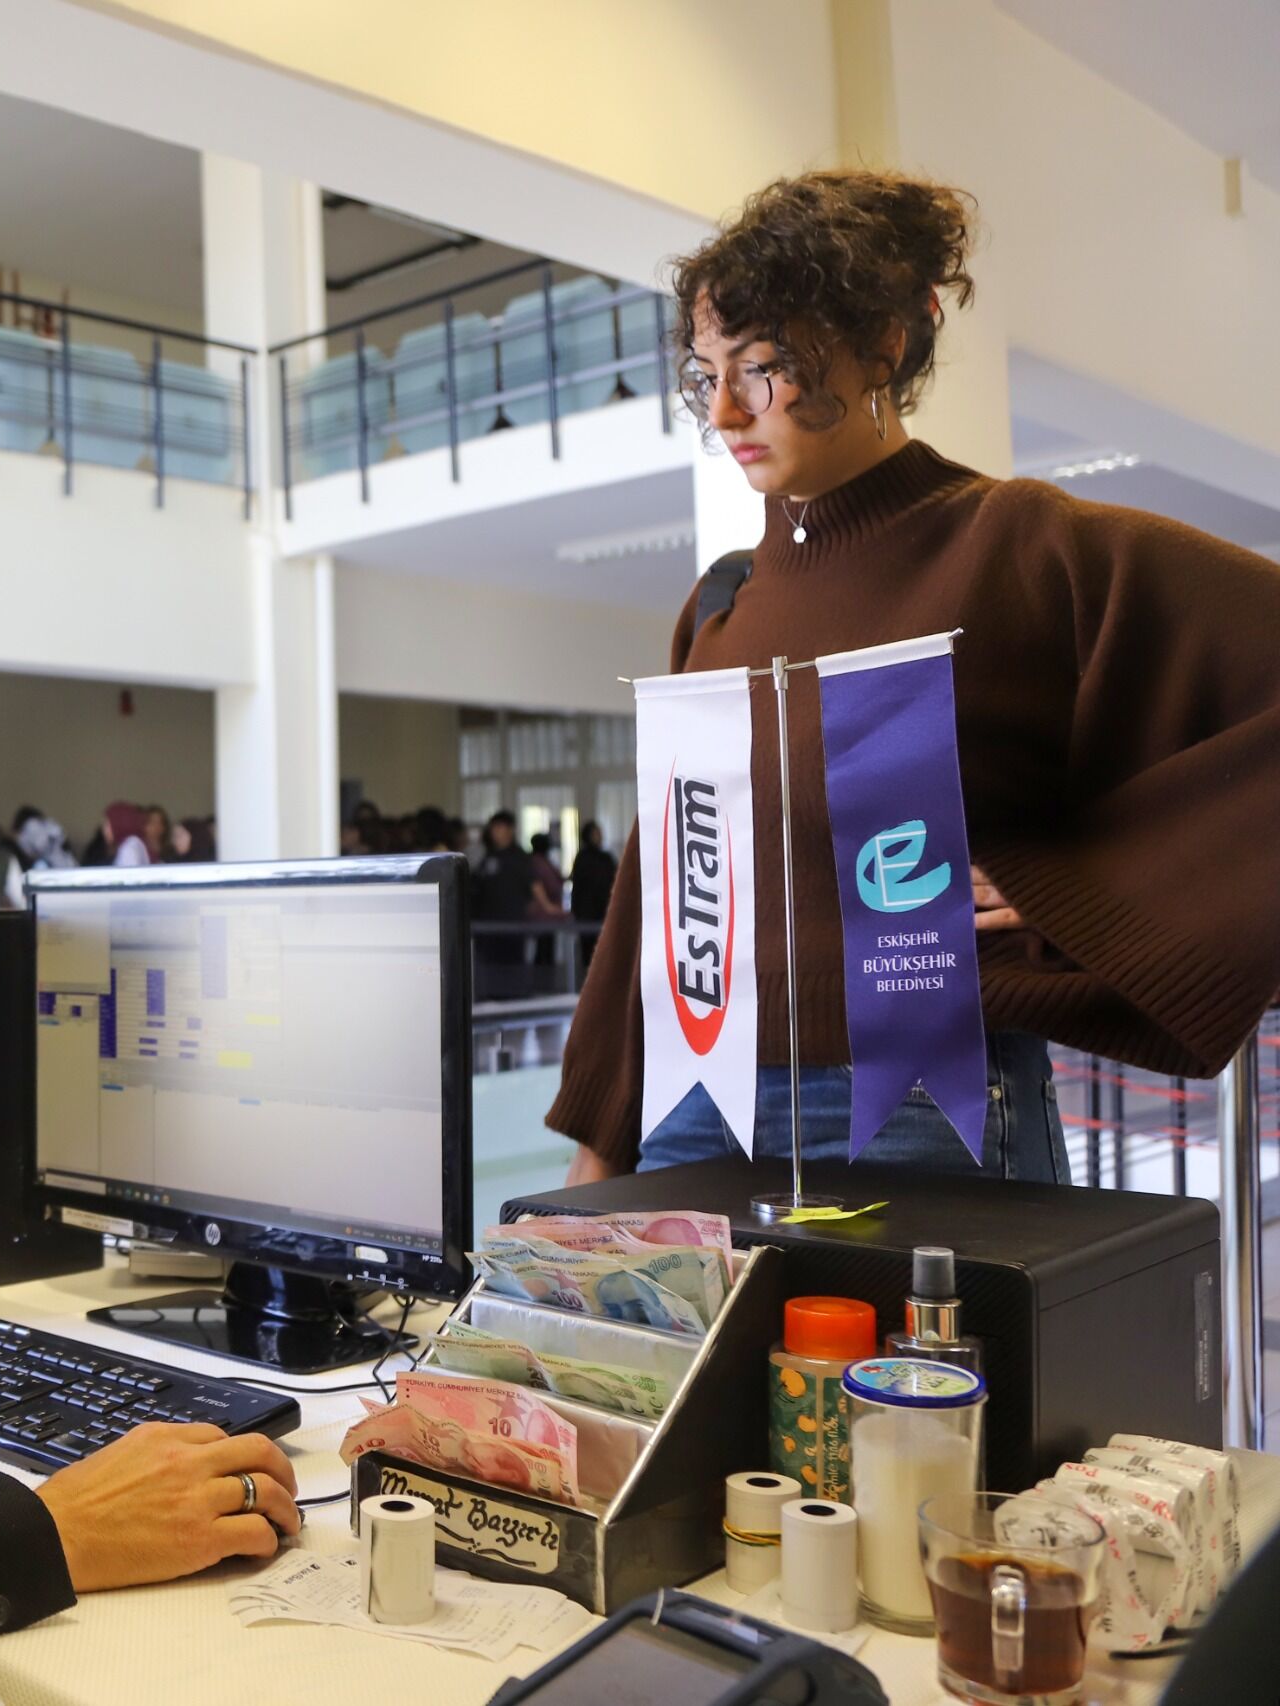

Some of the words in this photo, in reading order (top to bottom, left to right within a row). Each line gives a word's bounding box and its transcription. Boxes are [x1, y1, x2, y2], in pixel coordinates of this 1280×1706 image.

[877, 930, 940, 949] ESKİŞEHİR
[863, 951, 957, 974] BÜYÜKŞEHİR
[877, 974, 944, 992] BELEDİYESİ
[649, 1253, 682, 1275] 100
[552, 1289, 583, 1310] 100
[488, 1417, 512, 1438] 10
